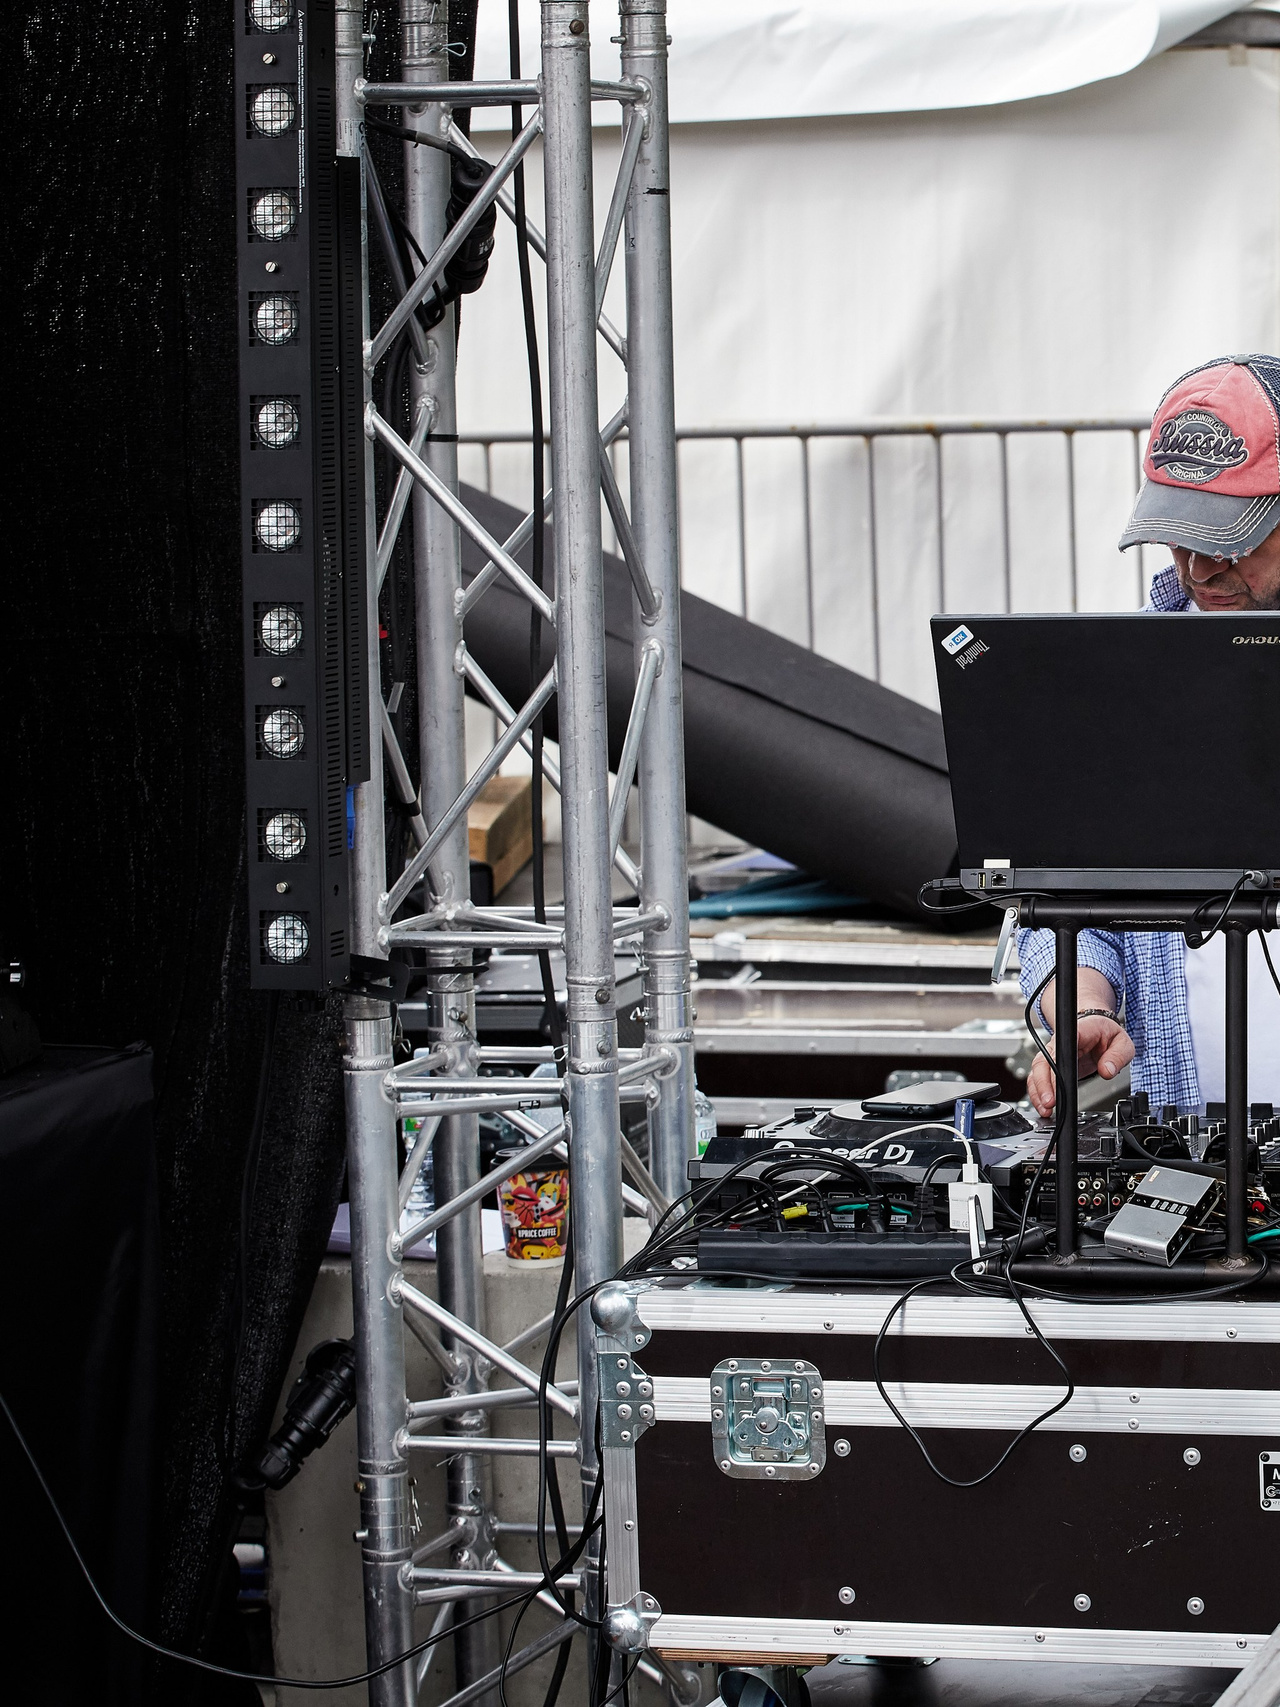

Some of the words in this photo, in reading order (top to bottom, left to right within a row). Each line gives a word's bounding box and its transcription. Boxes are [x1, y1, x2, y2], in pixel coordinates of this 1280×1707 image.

[1187, 413, 1215, 425] COUNTRY
[1151, 418, 1248, 460] Russia
[1172, 465, 1207, 479] ORIGINAL
[955, 639, 990, 670] ThinkPad
[537, 1227, 557, 1238] COFFEE
